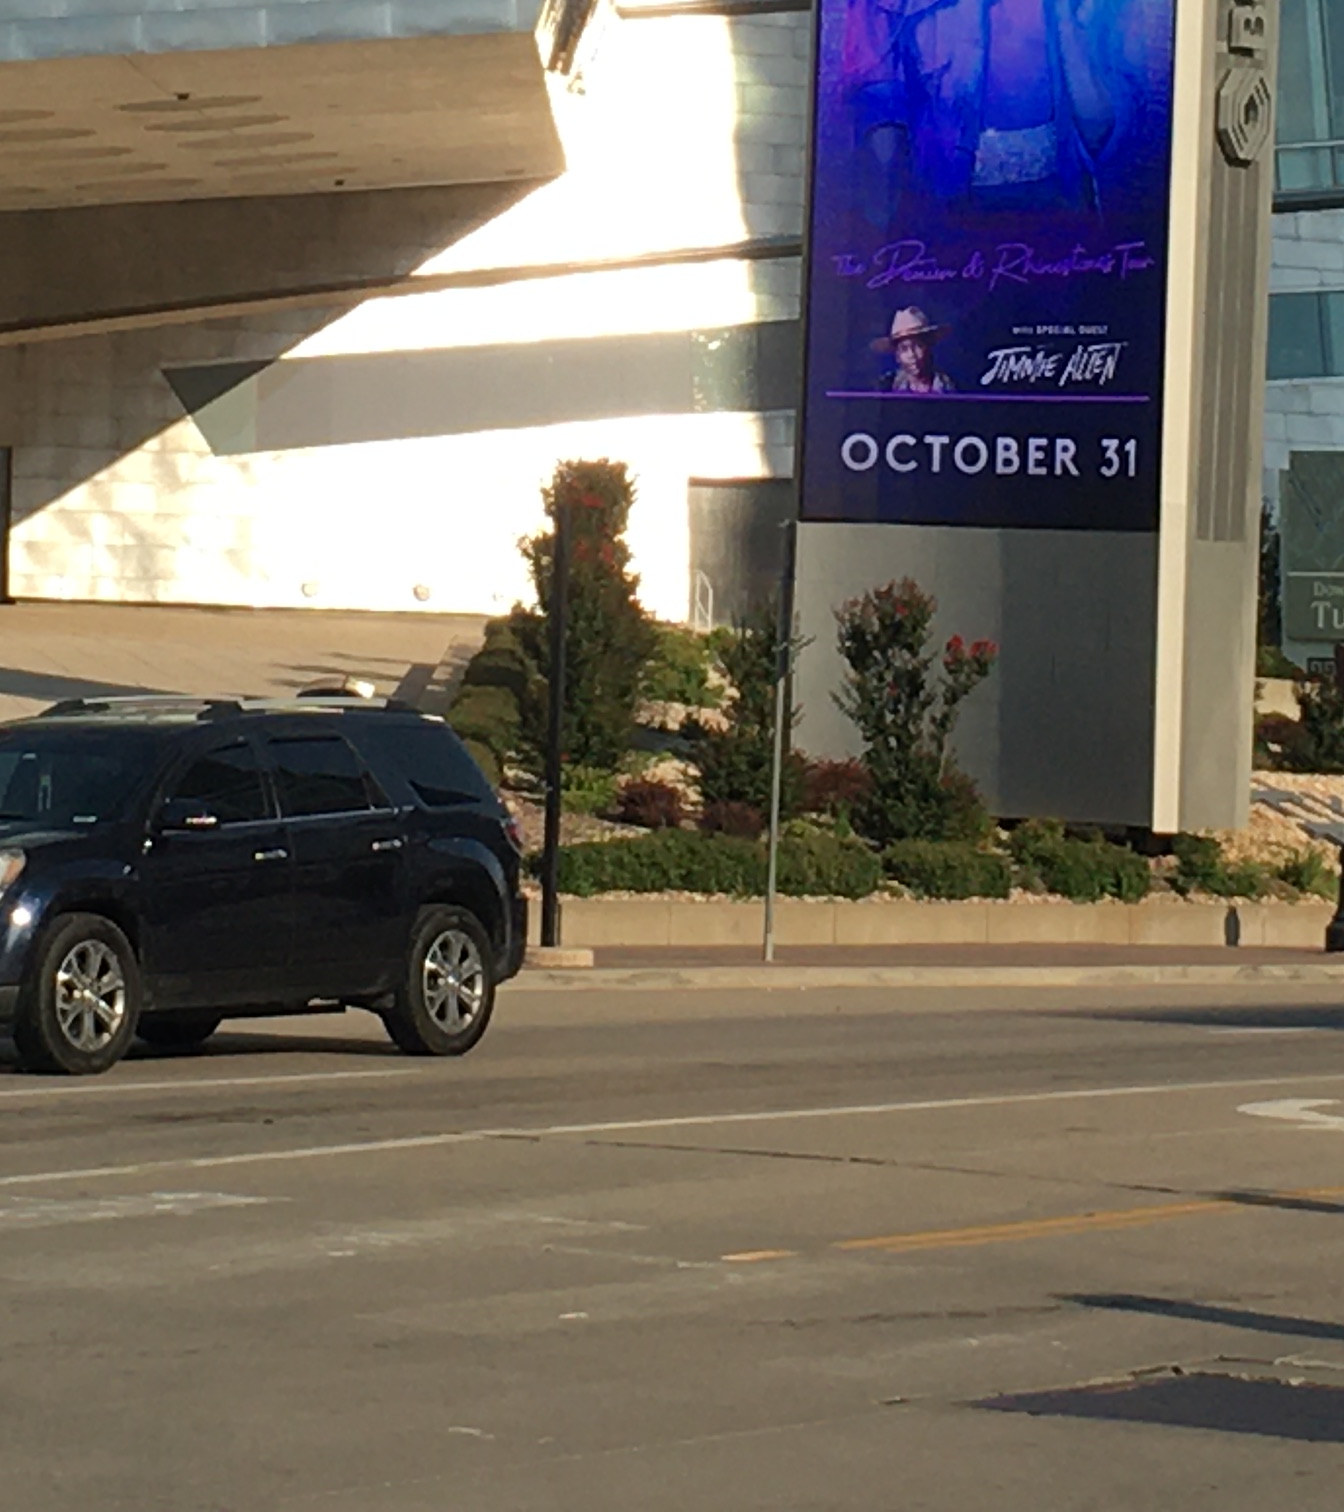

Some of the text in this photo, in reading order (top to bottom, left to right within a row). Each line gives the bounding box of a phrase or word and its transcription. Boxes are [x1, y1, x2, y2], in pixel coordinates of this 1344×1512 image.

[831, 254, 866, 276] The
[840, 433, 1138, 478] OCTOBER 31
